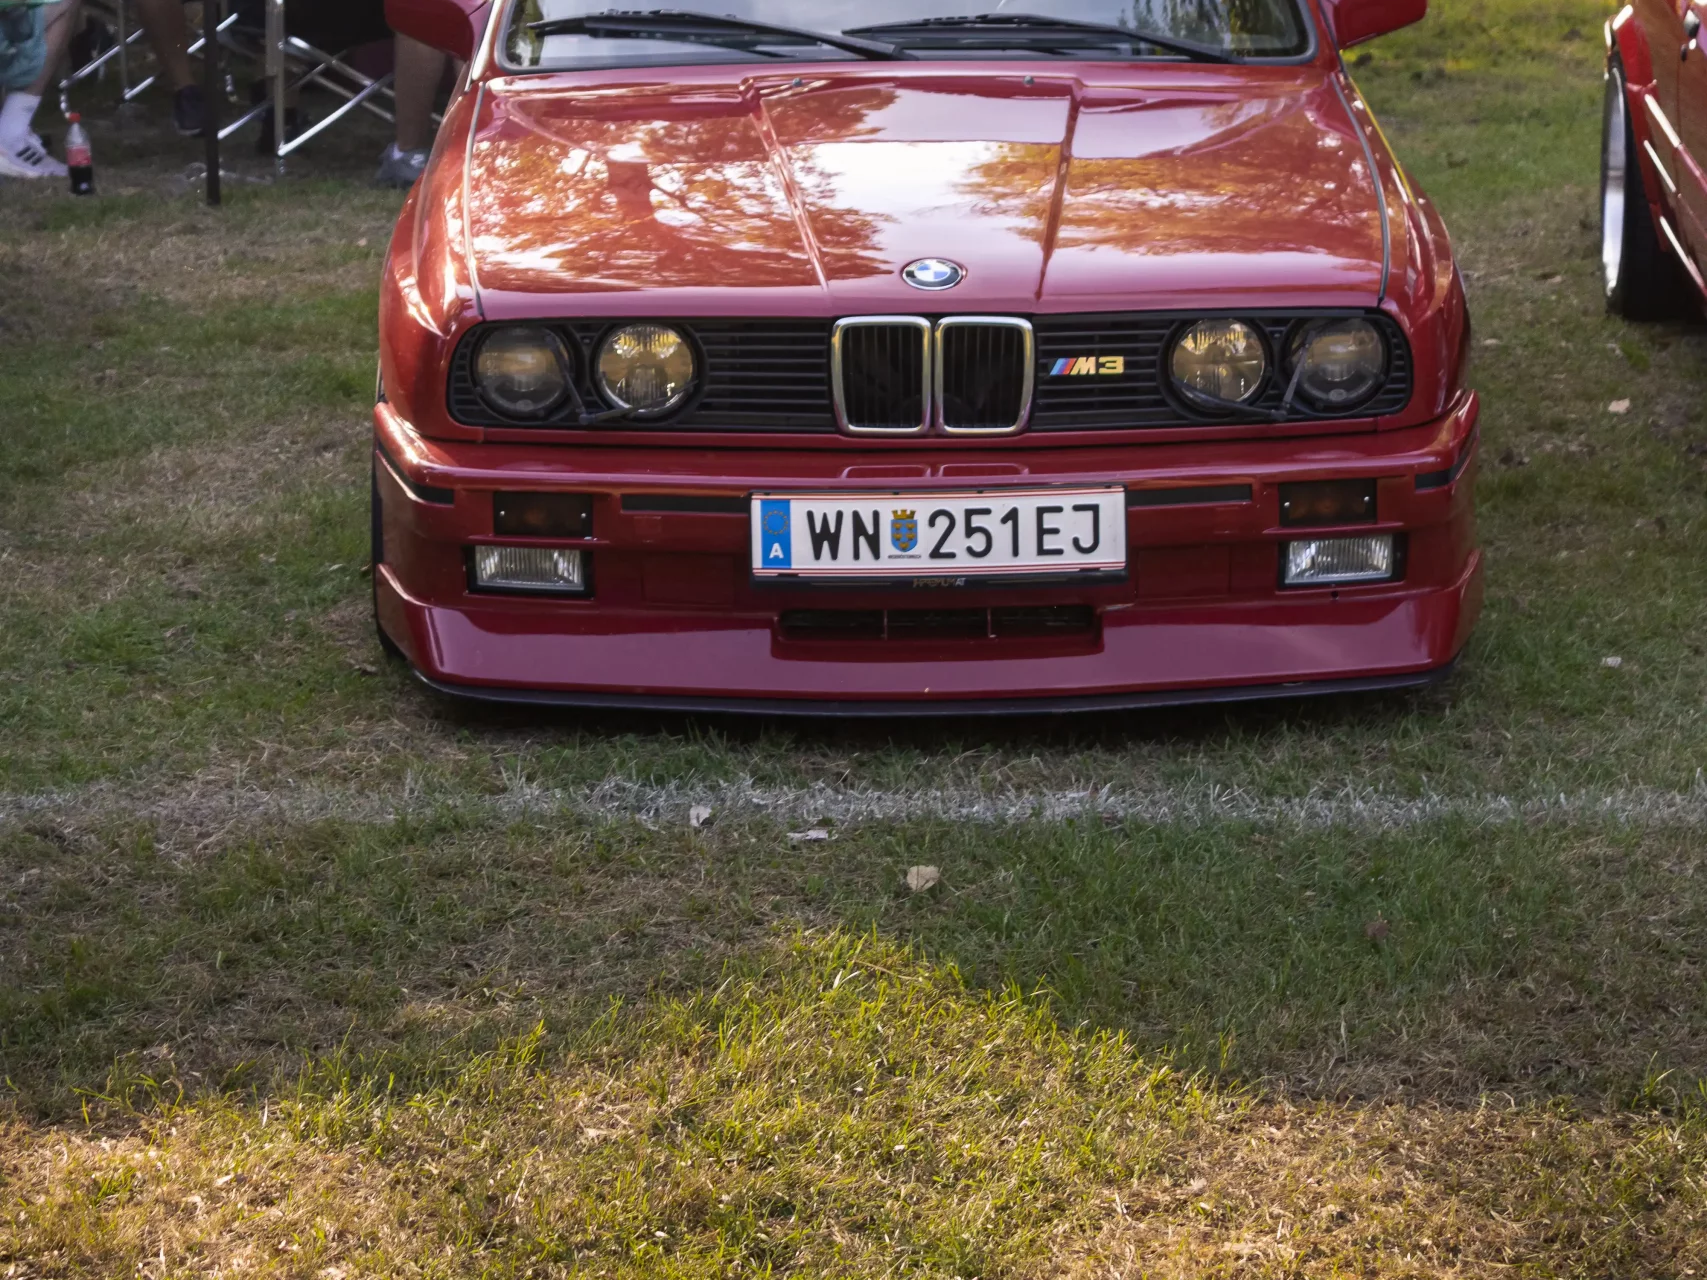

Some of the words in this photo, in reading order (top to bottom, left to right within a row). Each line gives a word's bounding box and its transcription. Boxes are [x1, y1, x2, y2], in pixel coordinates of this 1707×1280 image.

[1069, 355, 1124, 376] M3
[806, 509, 881, 561] WN
[769, 542, 784, 559] A
